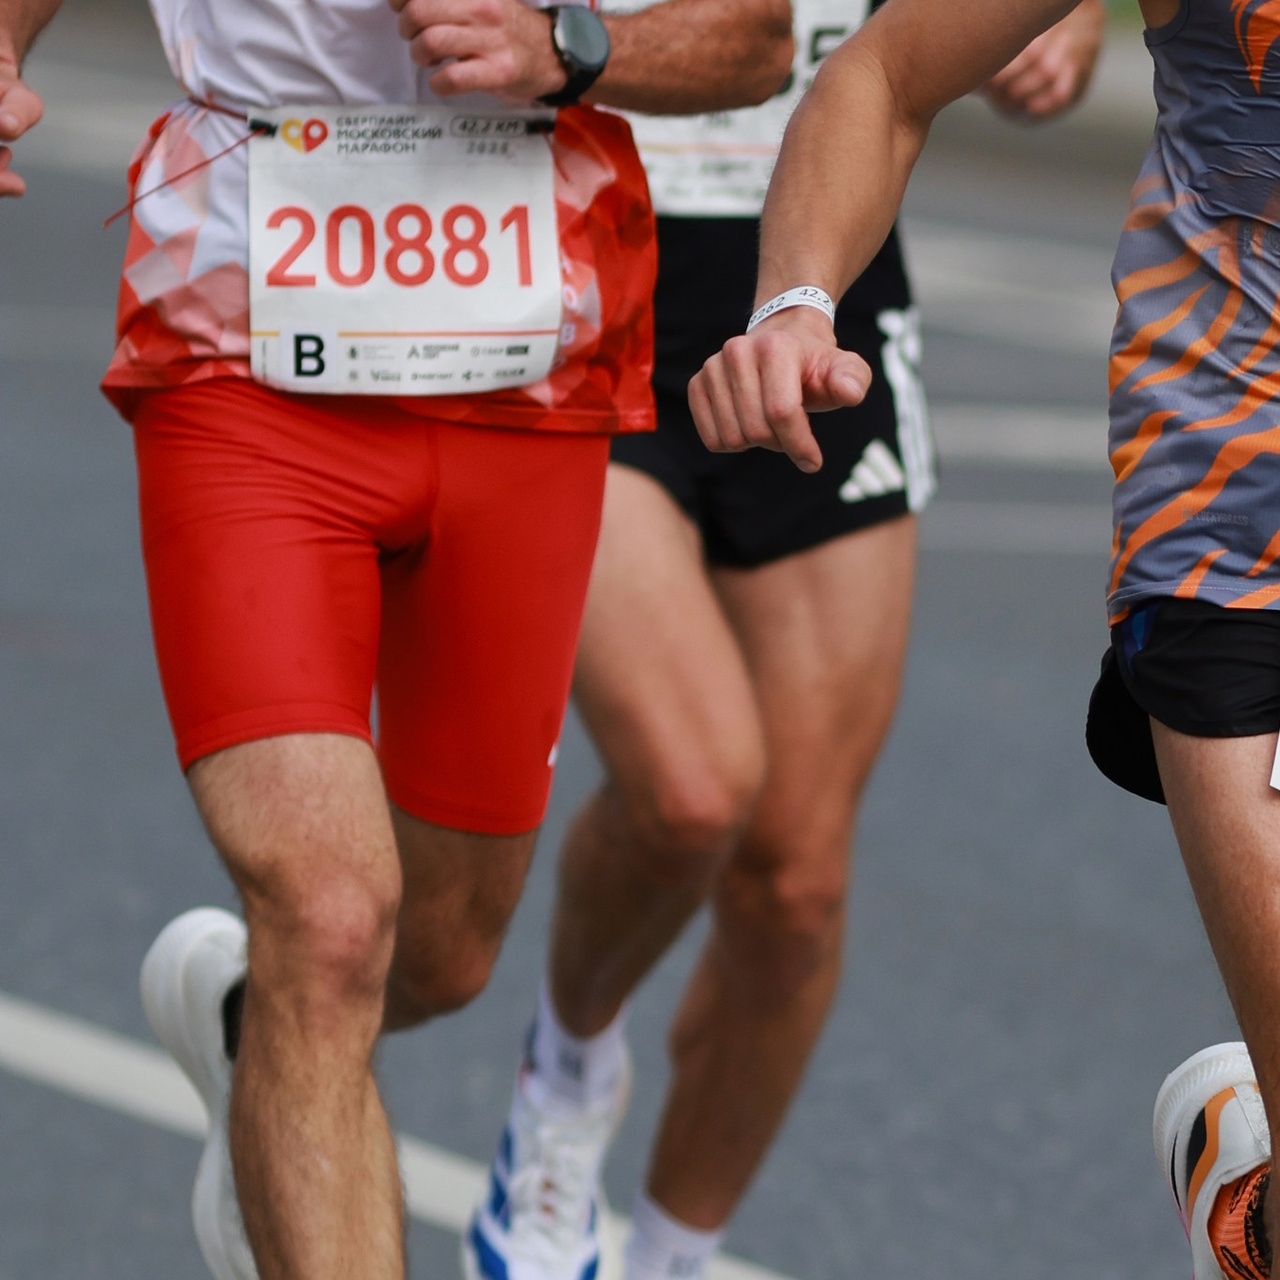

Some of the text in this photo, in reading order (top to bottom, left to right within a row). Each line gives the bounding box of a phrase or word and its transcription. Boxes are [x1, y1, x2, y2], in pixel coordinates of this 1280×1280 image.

[336, 126, 443, 140] МОСКОВСКИЙ
[336, 141, 416, 154] МАРАФОН
[265, 203, 533, 289] 20881
